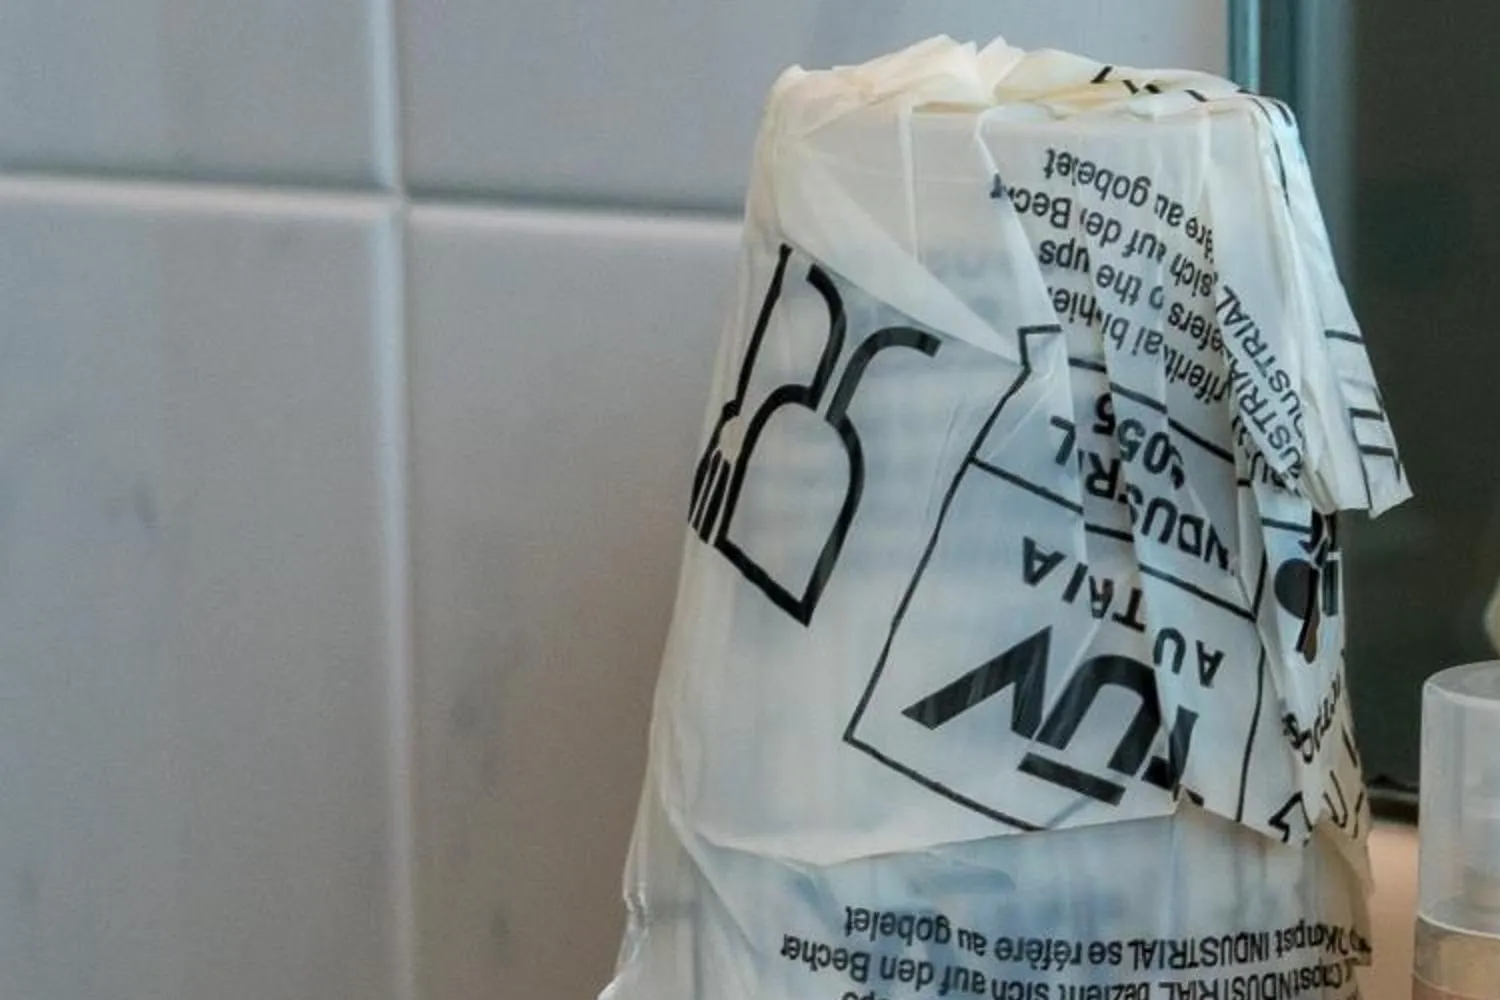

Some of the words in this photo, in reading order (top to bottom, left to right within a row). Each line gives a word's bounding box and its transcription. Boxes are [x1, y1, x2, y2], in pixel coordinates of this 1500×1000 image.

[1037, 236, 1091, 274] ups
[1095, 263, 1143, 307] the
[1167, 302, 1227, 355] efers
[1161, 342, 1230, 406] riferit
[1021, 535, 1225, 689] AUTRIA
[843, 905, 952, 947] gobelet
[955, 926, 988, 957] au
[993, 935, 1083, 973] réfère
[1087, 940, 1122, 967] se
[1125, 931, 1271, 971] INDUSTRIAL
[879, 954, 935, 992] den
[937, 965, 987, 997] auf
